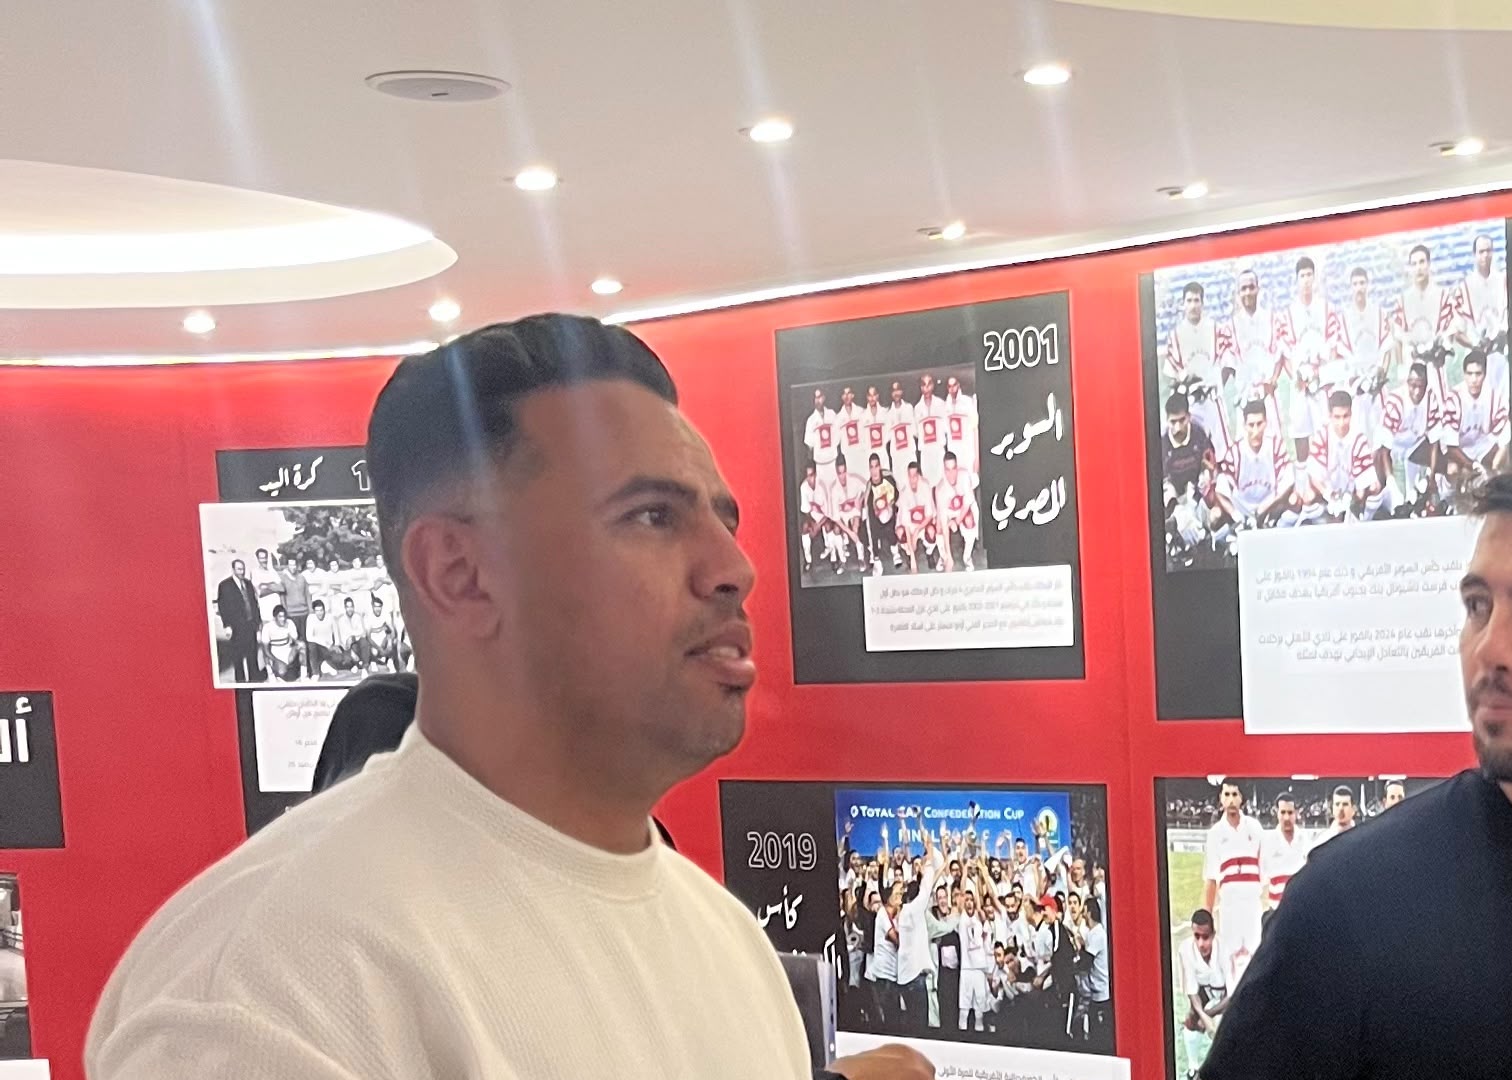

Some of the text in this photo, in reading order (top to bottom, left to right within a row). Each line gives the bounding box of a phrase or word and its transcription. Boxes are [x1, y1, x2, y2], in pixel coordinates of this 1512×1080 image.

[984, 323, 1059, 371] 2001
[990, 392, 1063, 460] السوبر
[259, 467, 291, 497] اليد
[294, 455, 324, 491] كرة
[991, 476, 1067, 530] المصري
[747, 831, 818, 872] 2019
[757, 885, 803, 929] كأس
